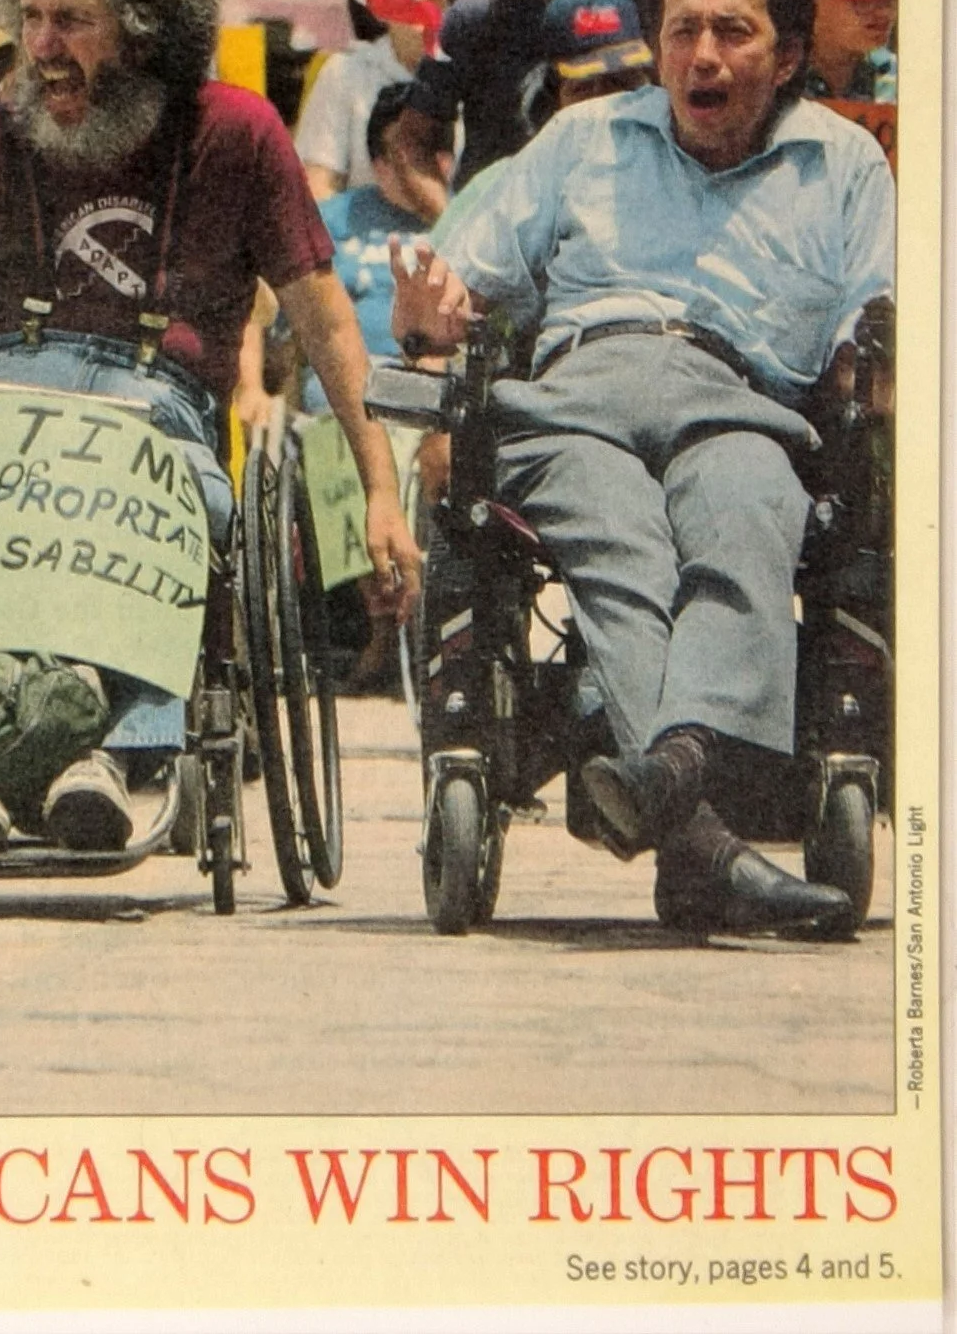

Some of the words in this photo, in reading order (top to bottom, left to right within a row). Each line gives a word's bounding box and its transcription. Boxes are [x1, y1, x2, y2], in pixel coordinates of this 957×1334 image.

[905, 805, 928, 845] Light
[905, 853, 926, 917] Antonio
[905, 923, 926, 1019] Barnes/San
[286, 1148, 499, 1226] WIN
[528, 1145, 900, 1224] RIGHTS
[567, 1253, 615, 1280] See
[624, 1256, 701, 1287] story,
[709, 1259, 788, 1286] pages
[795, 1254, 813, 1278] 4
[821, 1253, 869, 1278] and
[877, 1253, 902, 1278] 5.
